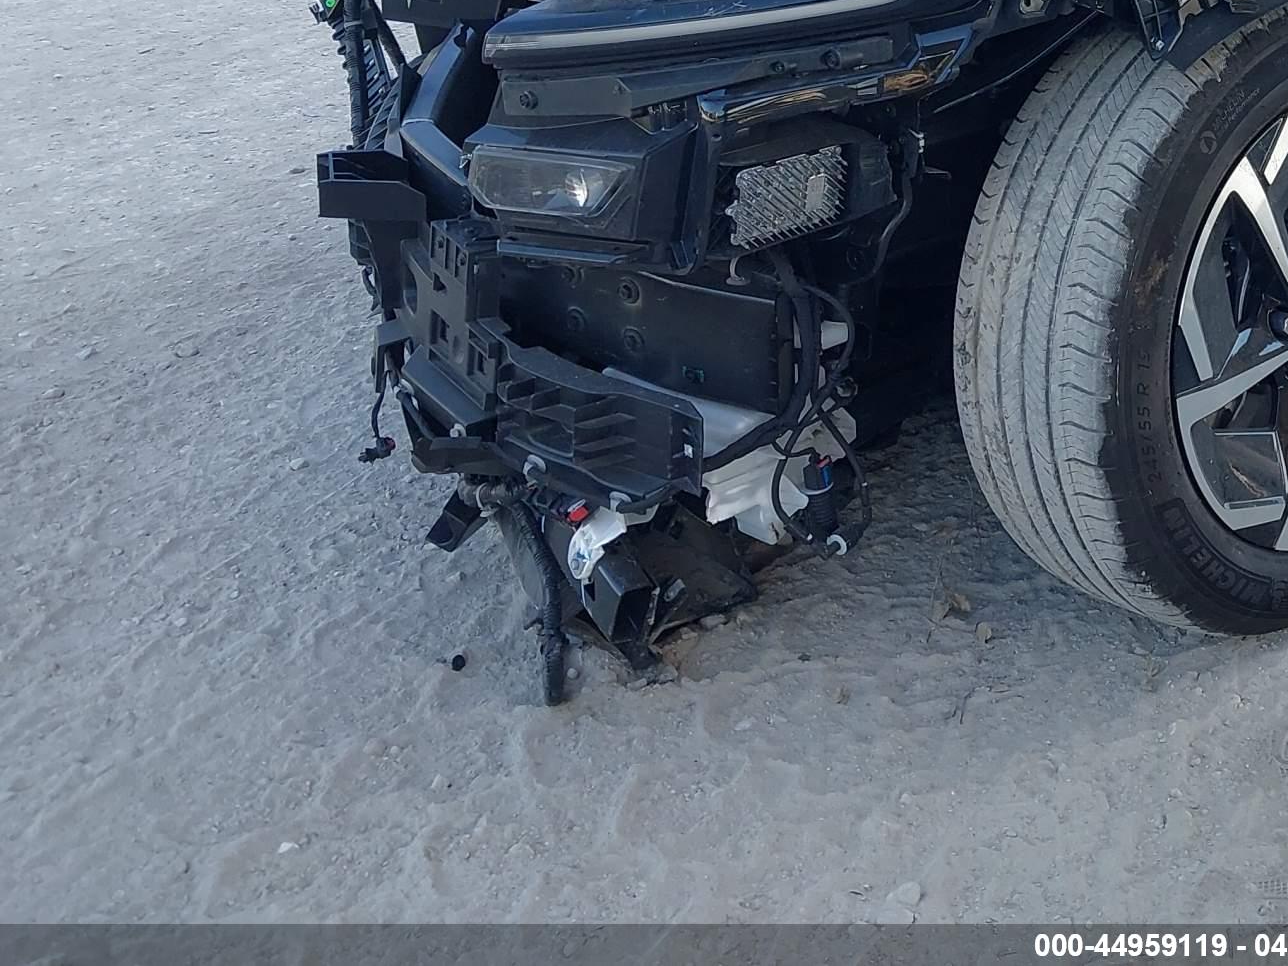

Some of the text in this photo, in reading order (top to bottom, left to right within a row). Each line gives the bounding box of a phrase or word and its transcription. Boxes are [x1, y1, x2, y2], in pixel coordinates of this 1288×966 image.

[1137, 382, 1150, 396] R
[1137, 406, 1163, 483] 245/55
[1162, 506, 1268, 604] MICHELIN
